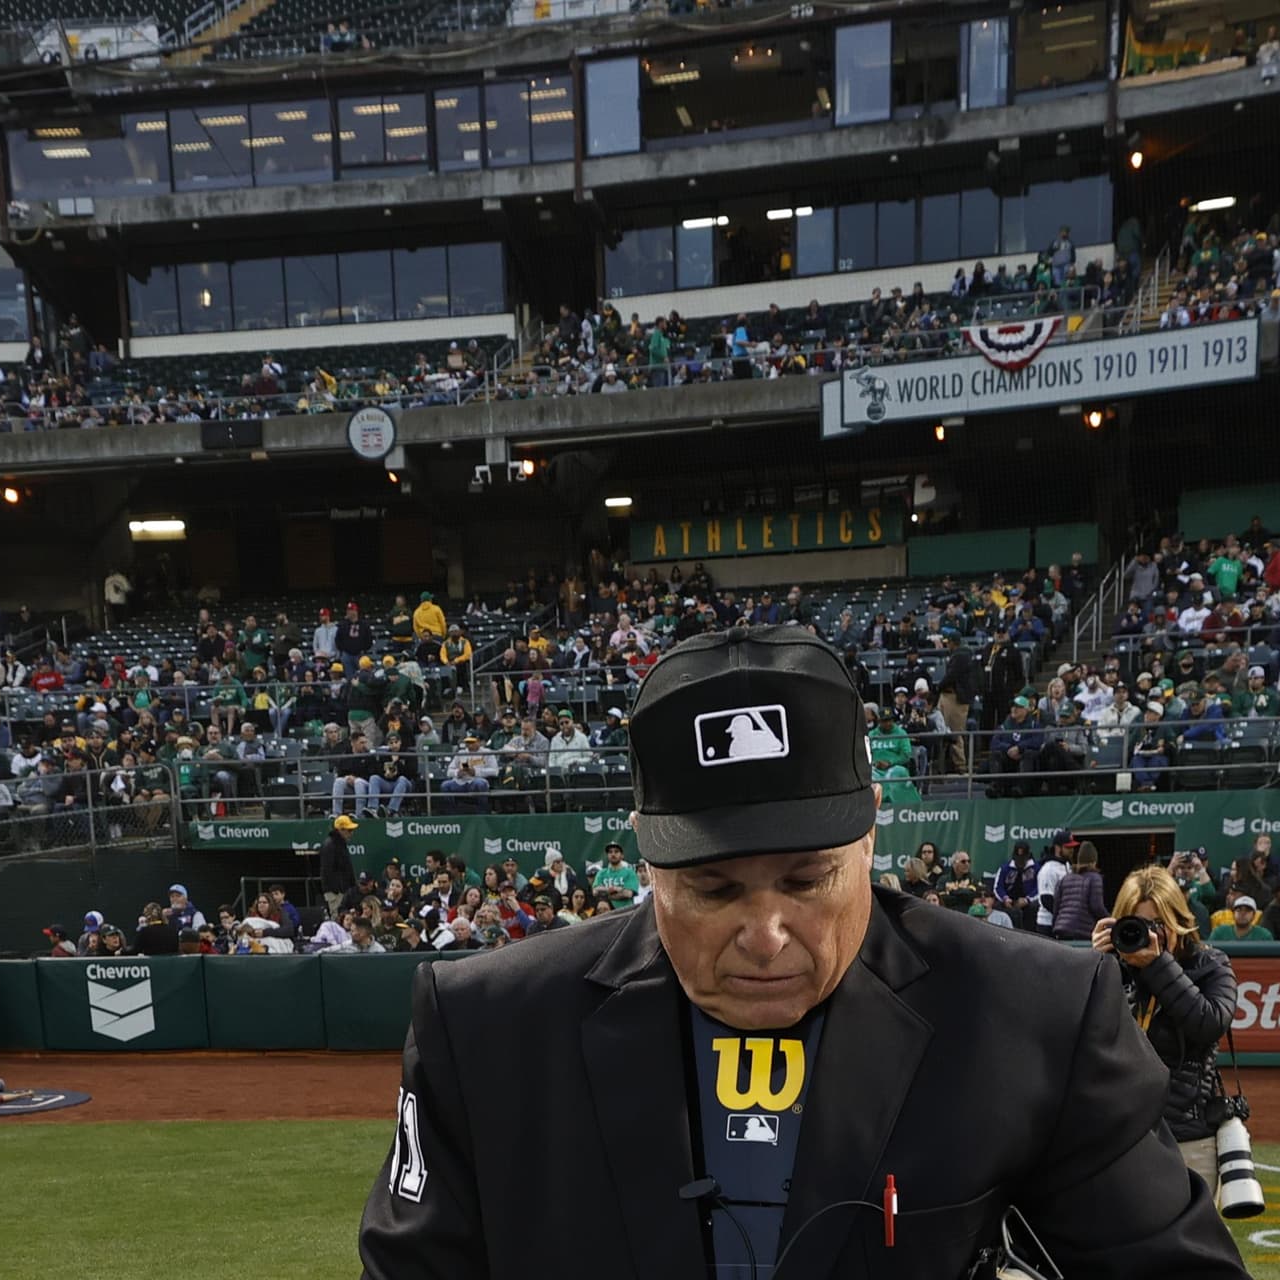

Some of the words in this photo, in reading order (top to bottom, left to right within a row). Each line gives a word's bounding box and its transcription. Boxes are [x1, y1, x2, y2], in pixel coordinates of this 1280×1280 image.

[897, 376, 964, 404] WORLD
[971, 358, 1084, 397] CHAMPIONS
[1094, 351, 1137, 382] 1910
[1148, 344, 1189, 375] 1911
[1202, 336, 1248, 368] 1913
[653, 508, 882, 557] ATHLETICS
[898, 808, 959, 823] Chevron
[1128, 801, 1195, 817] Chevron
[218, 824, 269, 839] Chevron
[407, 821, 461, 836] Chevron
[506, 838, 561, 853] Chevron
[86, 963, 150, 980] Chevron
